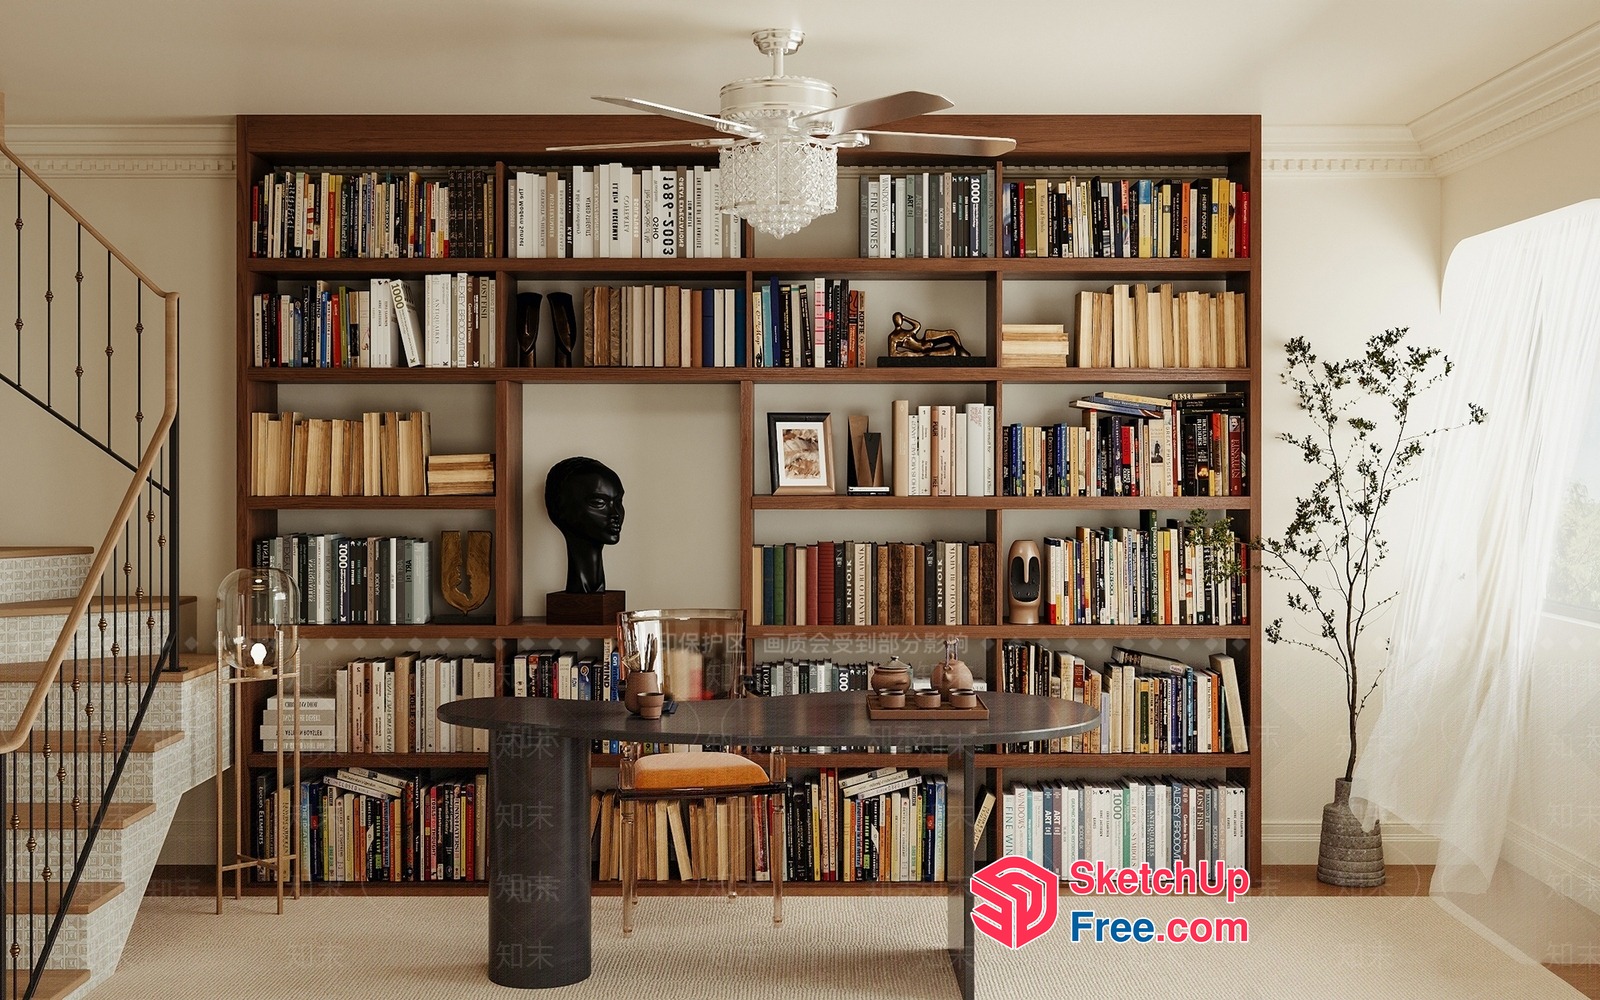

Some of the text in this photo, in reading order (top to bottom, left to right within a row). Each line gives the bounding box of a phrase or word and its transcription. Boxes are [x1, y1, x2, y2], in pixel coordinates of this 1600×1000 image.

[971, 178, 980, 203] 1000
[870, 192, 878, 249] FINE WINES
[391, 283, 404, 310] 1000
[612, 656, 617, 666] on
[1017, 791, 1025, 829] WINDOWS
[1113, 793, 1122, 820] 1000
[1173, 785, 1181, 819] ALEXEY
[1053, 810, 1061, 825] ART
[1005, 807, 1013, 856] FINE WIN
